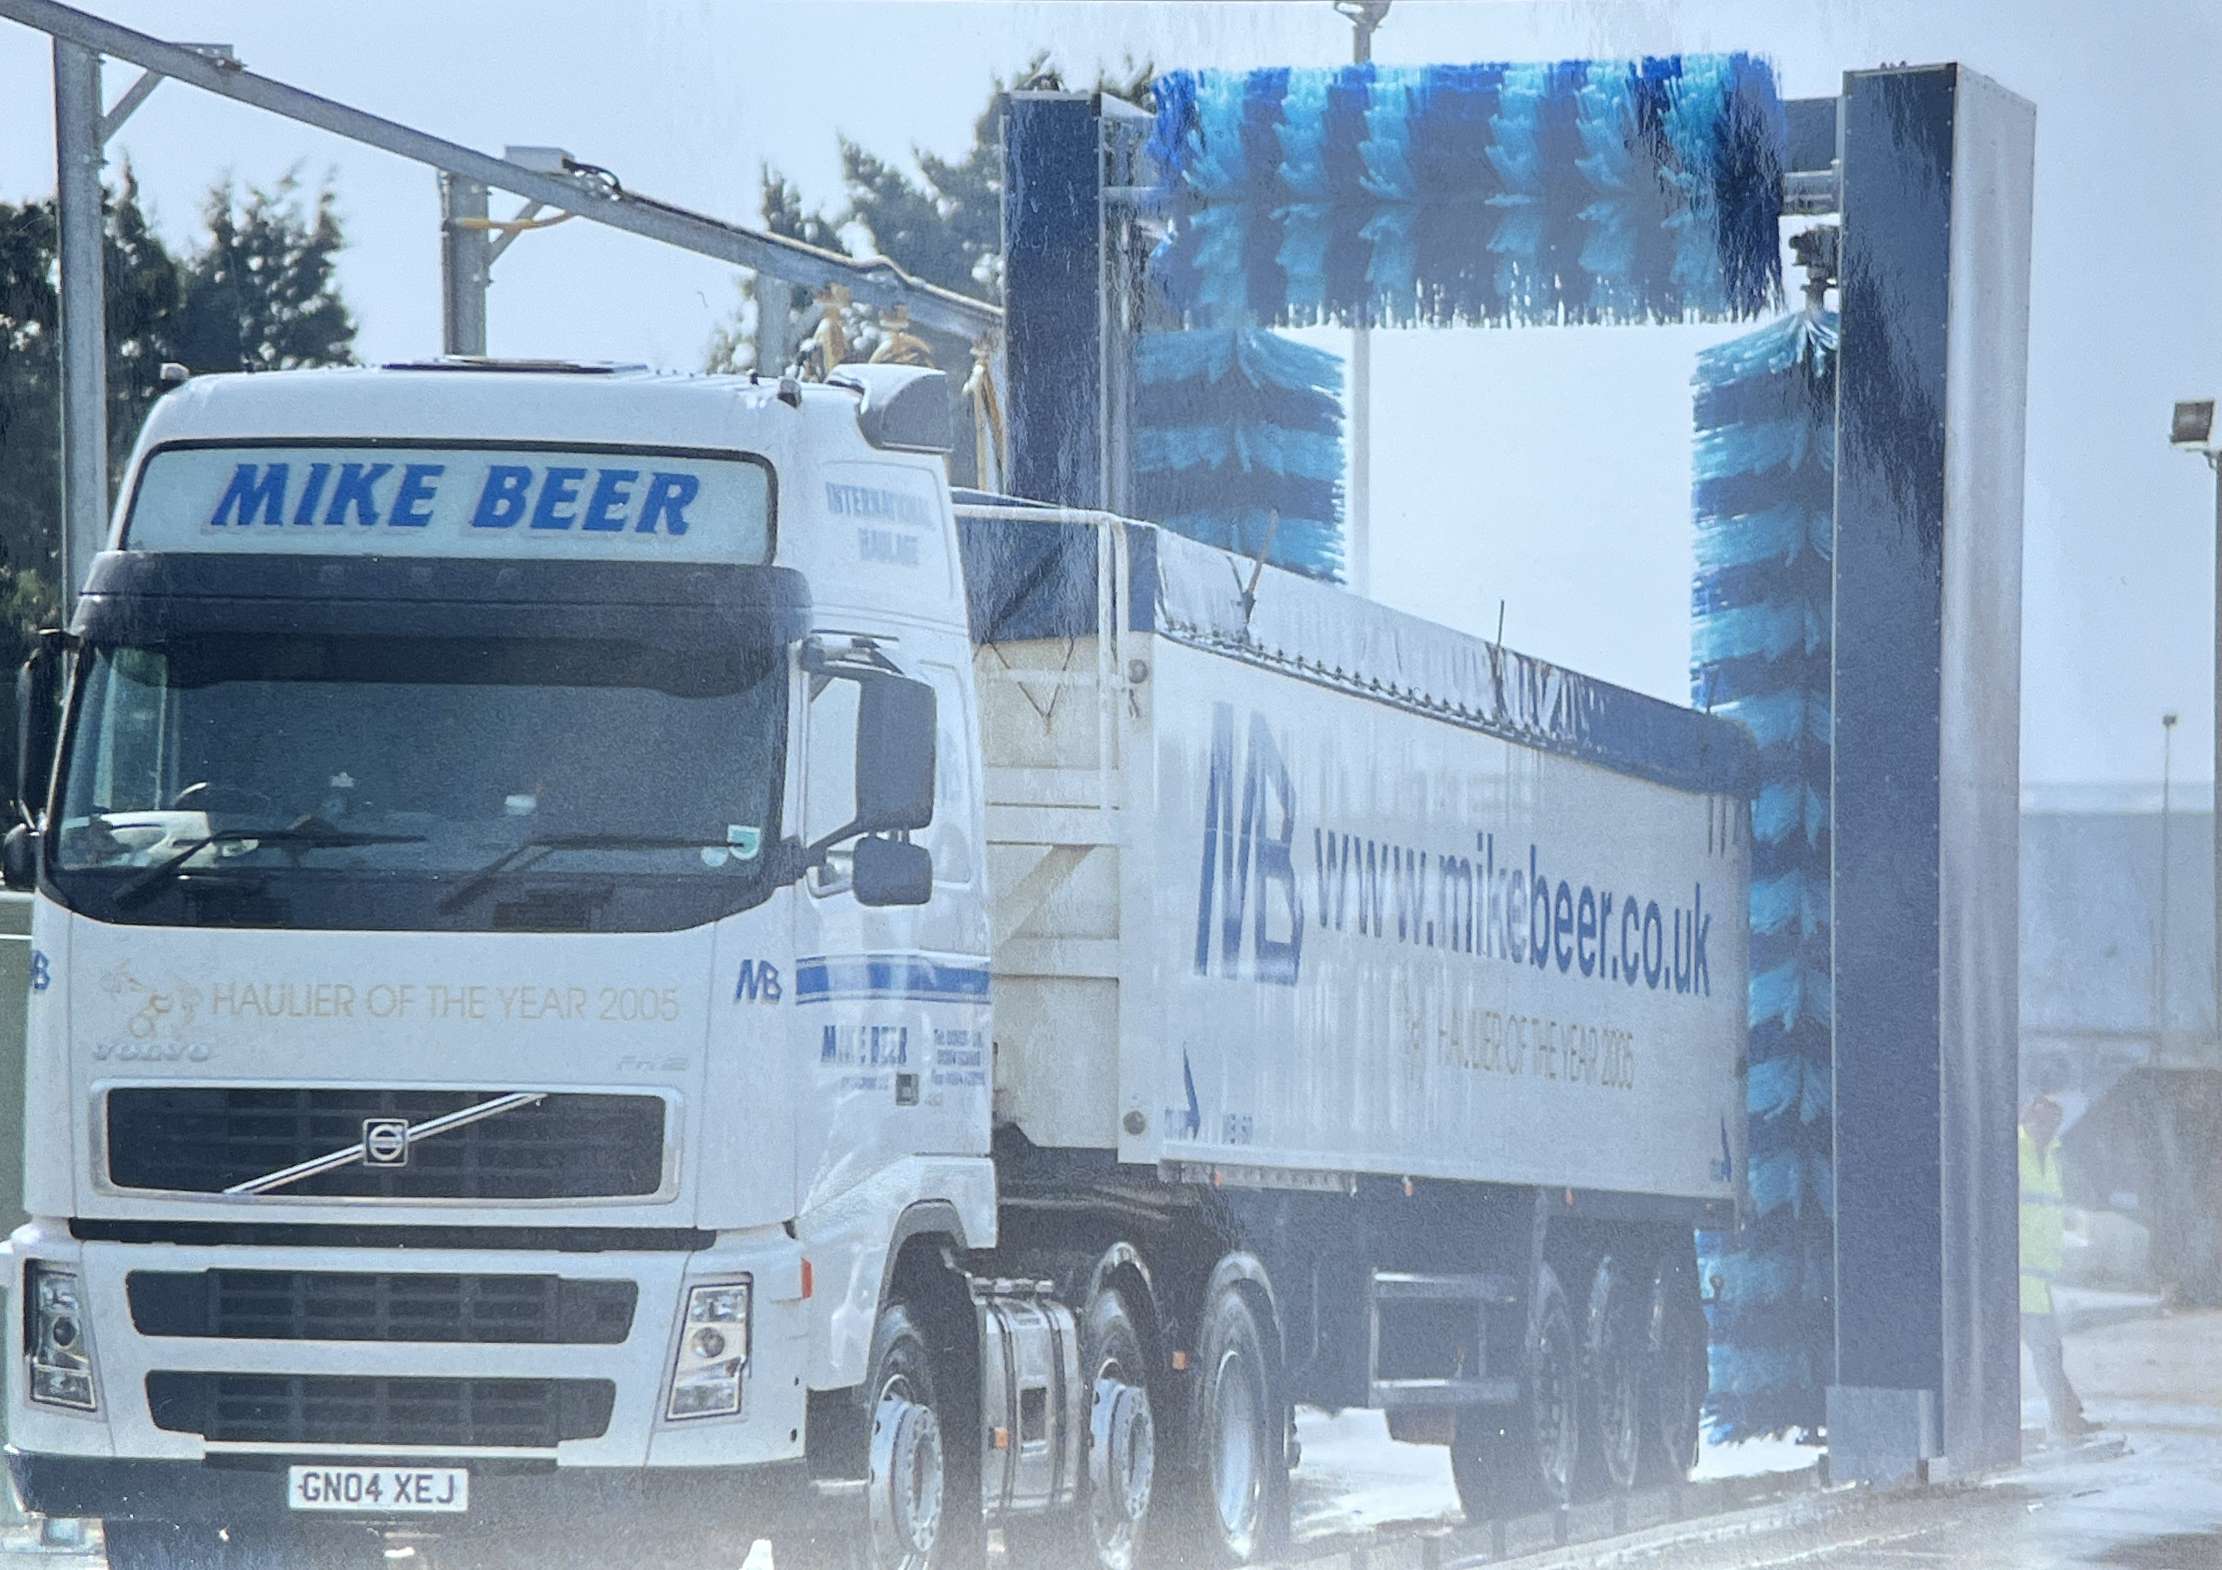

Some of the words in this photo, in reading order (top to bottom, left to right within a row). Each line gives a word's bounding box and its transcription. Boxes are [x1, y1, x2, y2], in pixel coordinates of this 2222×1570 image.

[211, 463, 445, 527] MIKE
[472, 464, 699, 536] BEER
[1313, 826, 1713, 998] www.mikebeer.co.uk
[211, 979, 356, 1018] HAULIER
[366, 983, 416, 1019] OF
[426, 984, 487, 1020] THE
[497, 985, 587, 1021] YEAR
[599, 986, 681, 1022] 2005
[734, 958, 783, 1003] MB
[303, 1471, 383, 1503] GN04
[394, 1473, 455, 1504] XEJ
